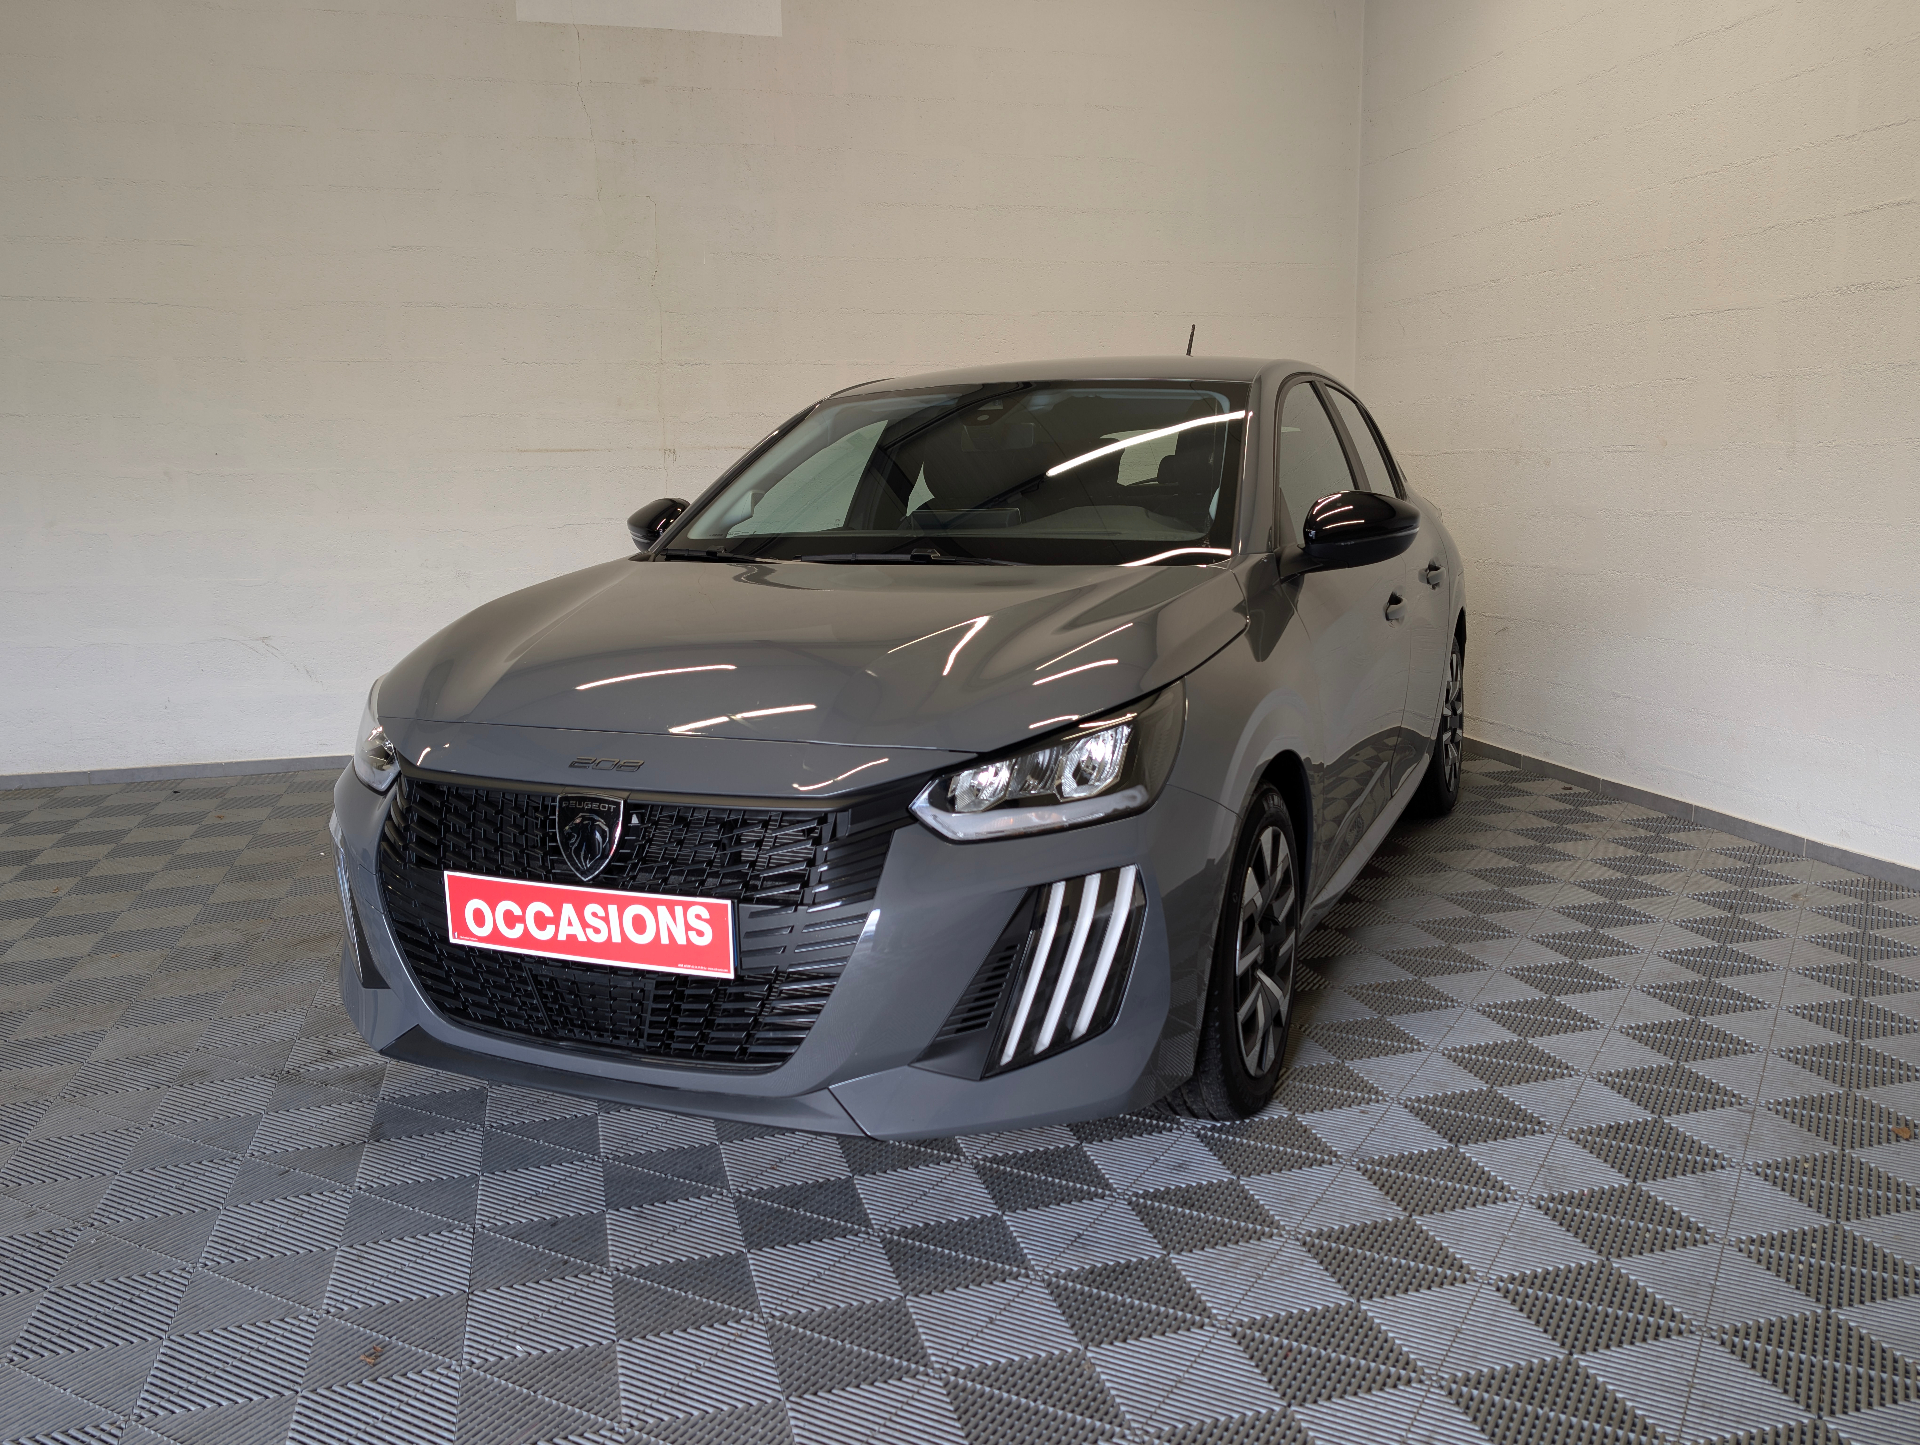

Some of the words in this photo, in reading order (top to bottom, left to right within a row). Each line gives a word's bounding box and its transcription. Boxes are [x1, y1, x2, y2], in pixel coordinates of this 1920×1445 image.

[568, 756, 645, 772] 208
[562, 800, 617, 812] PEUGEOT
[464, 898, 713, 946] OCCASIONS
